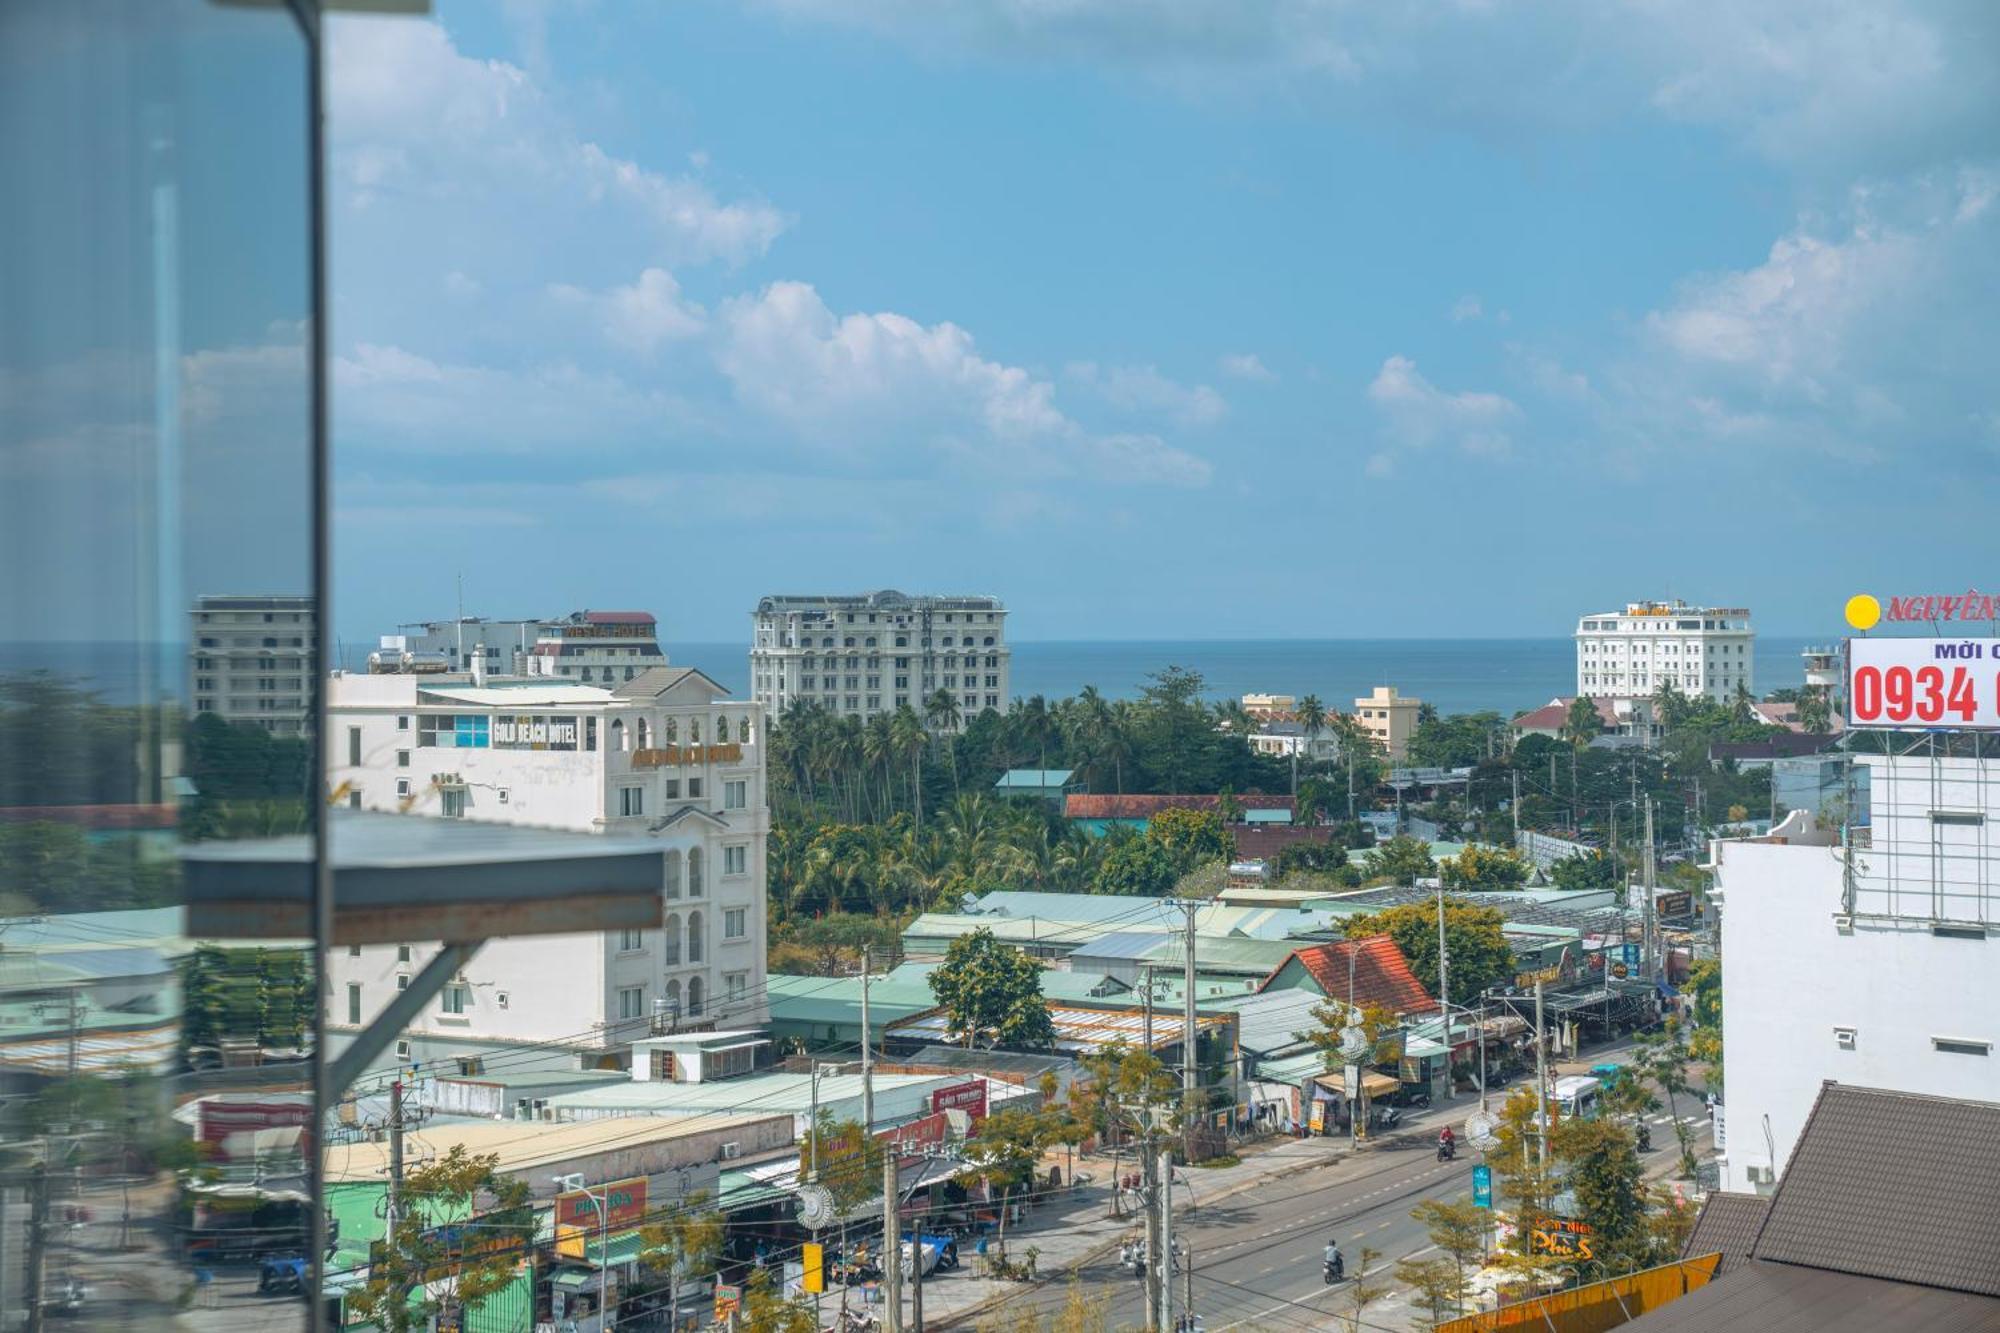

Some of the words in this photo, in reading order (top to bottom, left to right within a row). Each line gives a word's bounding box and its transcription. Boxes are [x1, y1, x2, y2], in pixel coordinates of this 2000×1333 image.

[1935, 640, 1982, 659] MỜI
[1854, 665, 1978, 722] 0934
[494, 722, 516, 742] GOLD
[518, 723, 546, 743] BEACH
[549, 724, 577, 744] HOTEL
